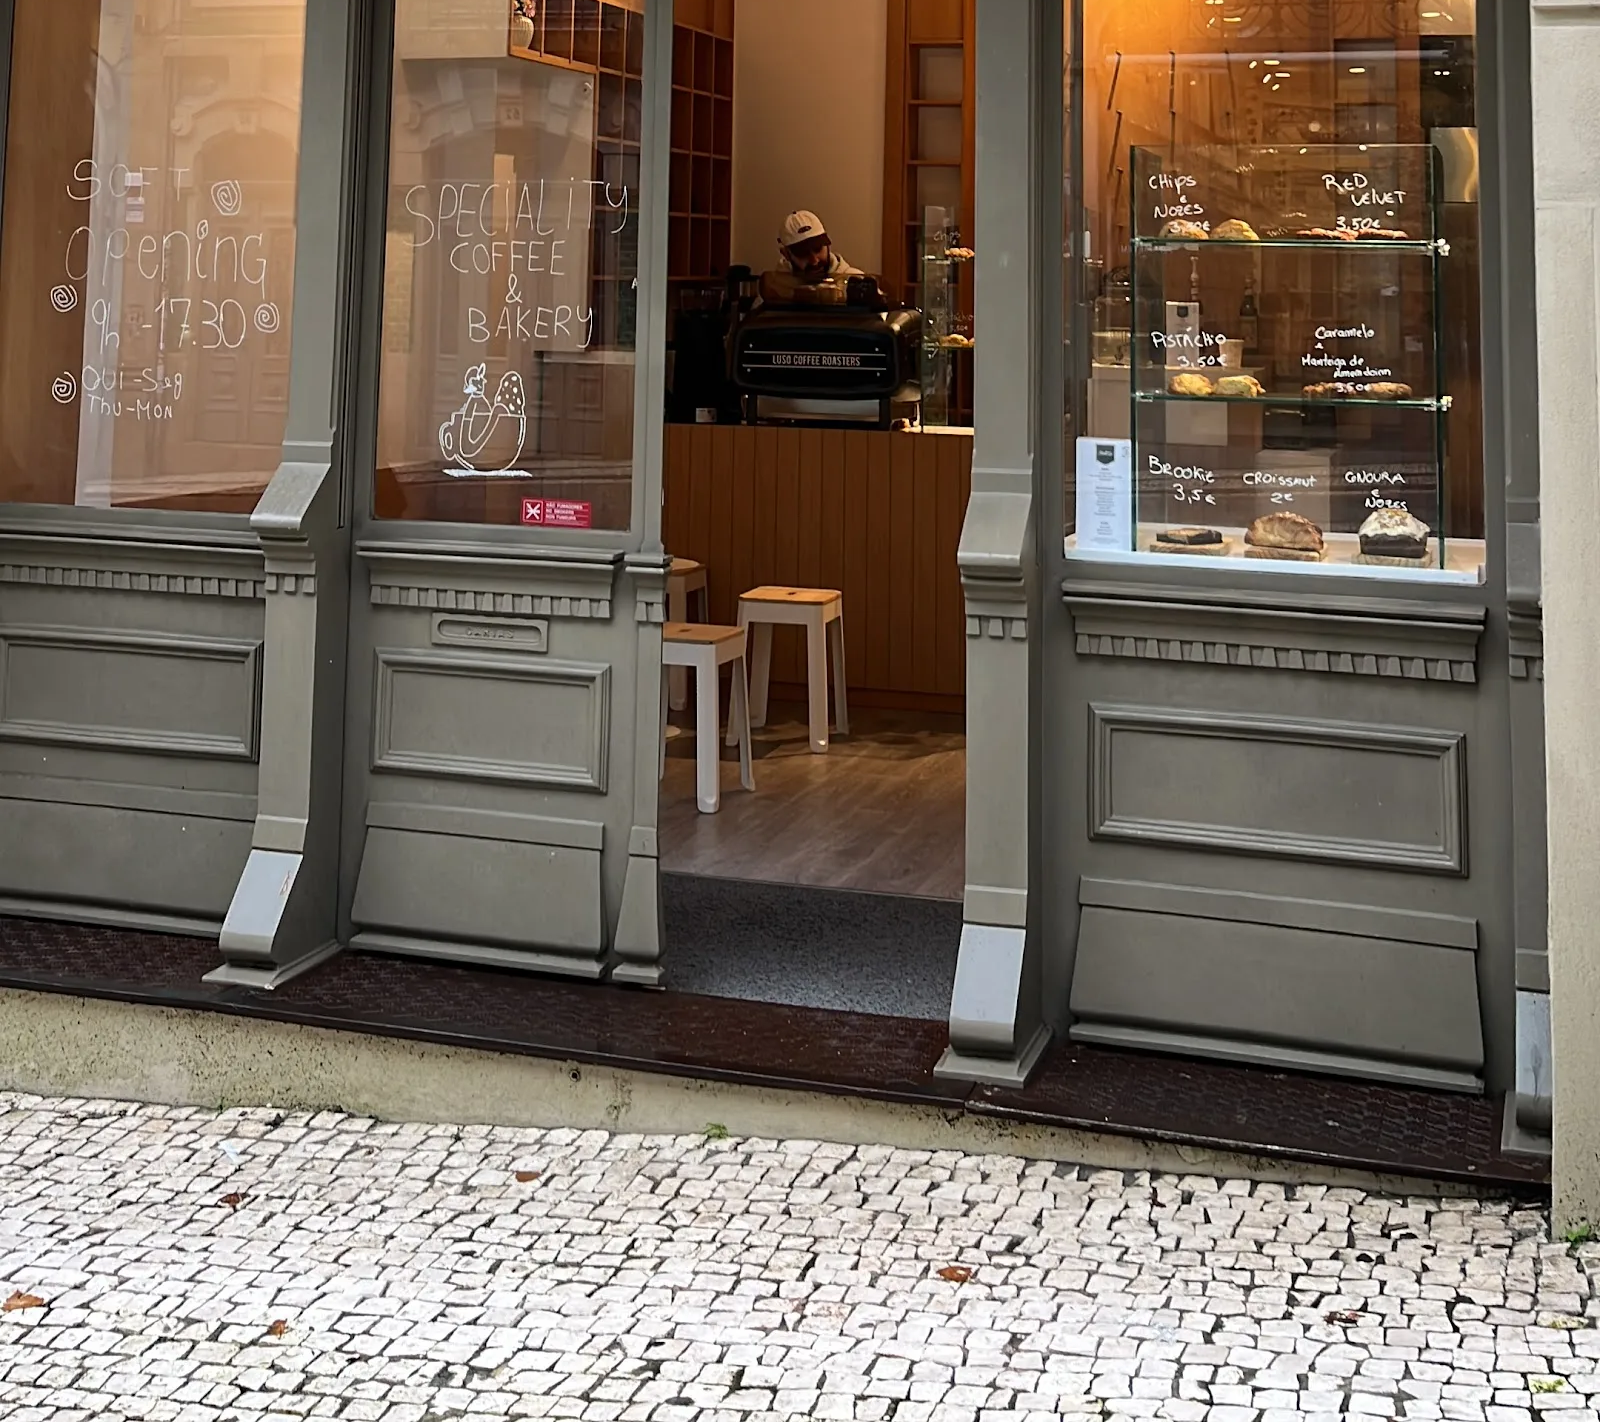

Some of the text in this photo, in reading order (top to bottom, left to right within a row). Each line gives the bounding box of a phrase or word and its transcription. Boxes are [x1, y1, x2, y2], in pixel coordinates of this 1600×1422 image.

[449, 239, 566, 276] COFFEE
[504, 273, 523, 304] &
[772, 354, 861, 367] LUSO COFFEE ROASTERS
[1349, 354, 1365, 367] de
